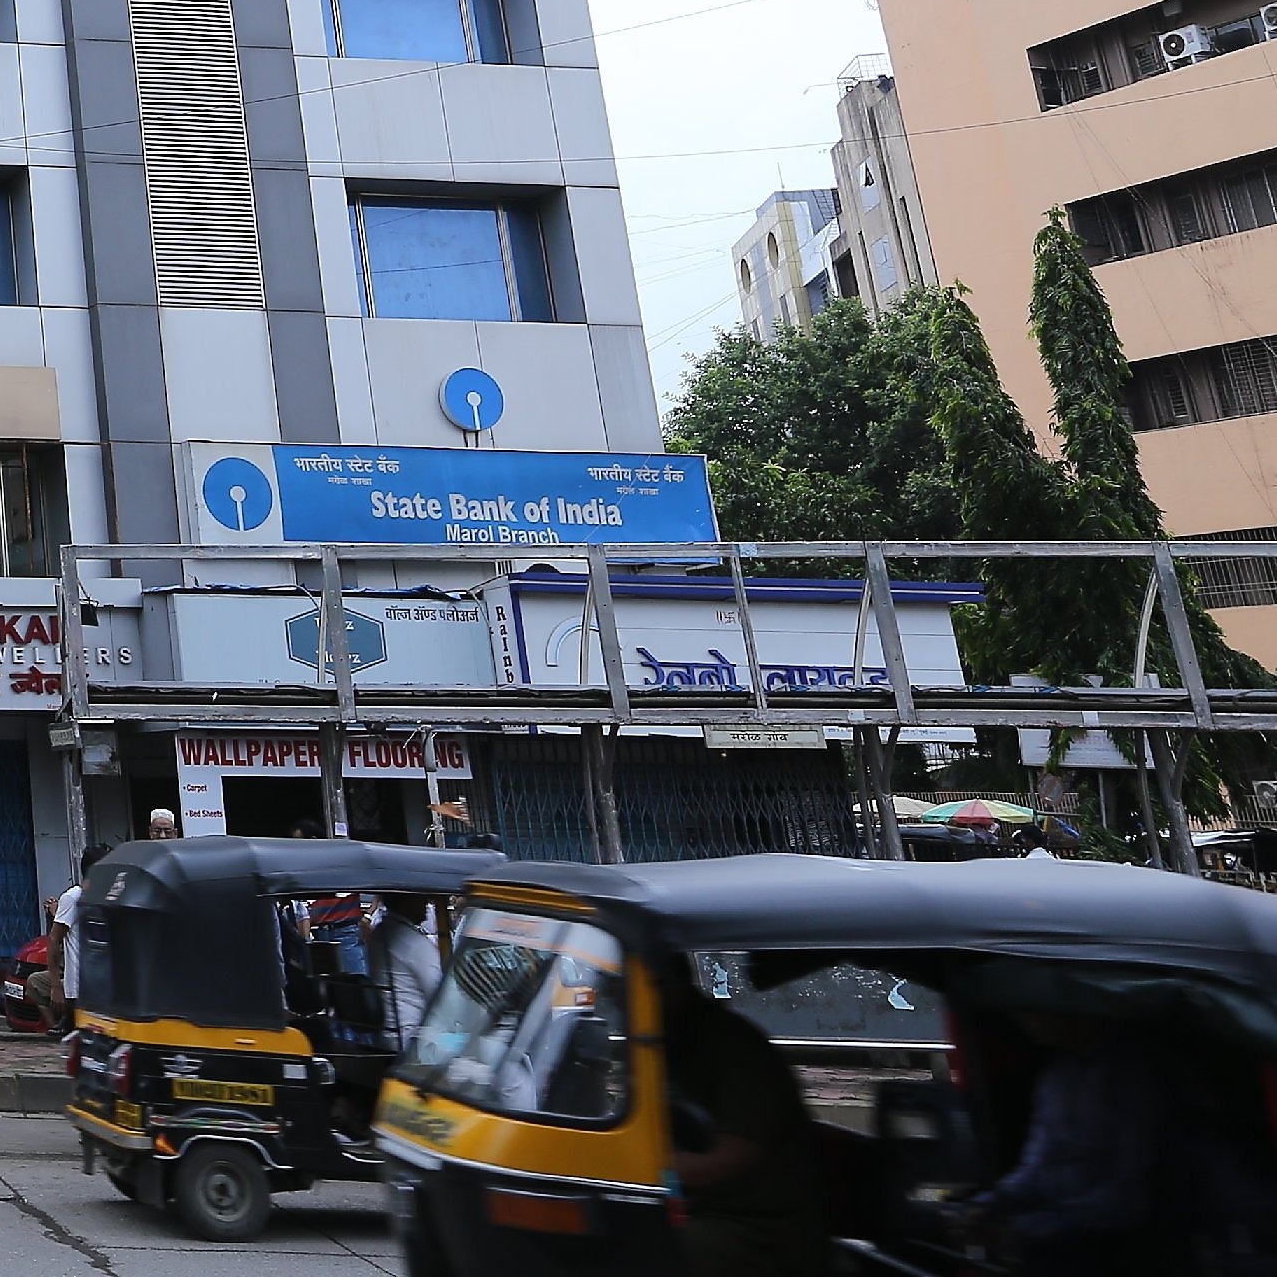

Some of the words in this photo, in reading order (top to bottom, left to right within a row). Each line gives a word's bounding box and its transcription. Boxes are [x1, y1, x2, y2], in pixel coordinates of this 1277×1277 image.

[294, 453, 343, 472] भारतीय
[345, 455, 374, 473] स्टेट
[588, 463, 632, 482] भारतीय
[635, 465, 660, 483] स्टेट
[370, 490, 443, 520] State
[448, 493, 518, 523] Bank
[523, 498, 550, 524] of
[557, 497, 622, 526] India
[446, 524, 494, 542] Marol
[498, 525, 560, 544] Branch
[179, 738, 320, 768] WALLPAPER
[348, 740, 464, 769] FLOORNG
[186, 784, 207, 793] Carpet
[189, 810, 201, 818] Bed
[202, 810, 223, 818] Sheets
